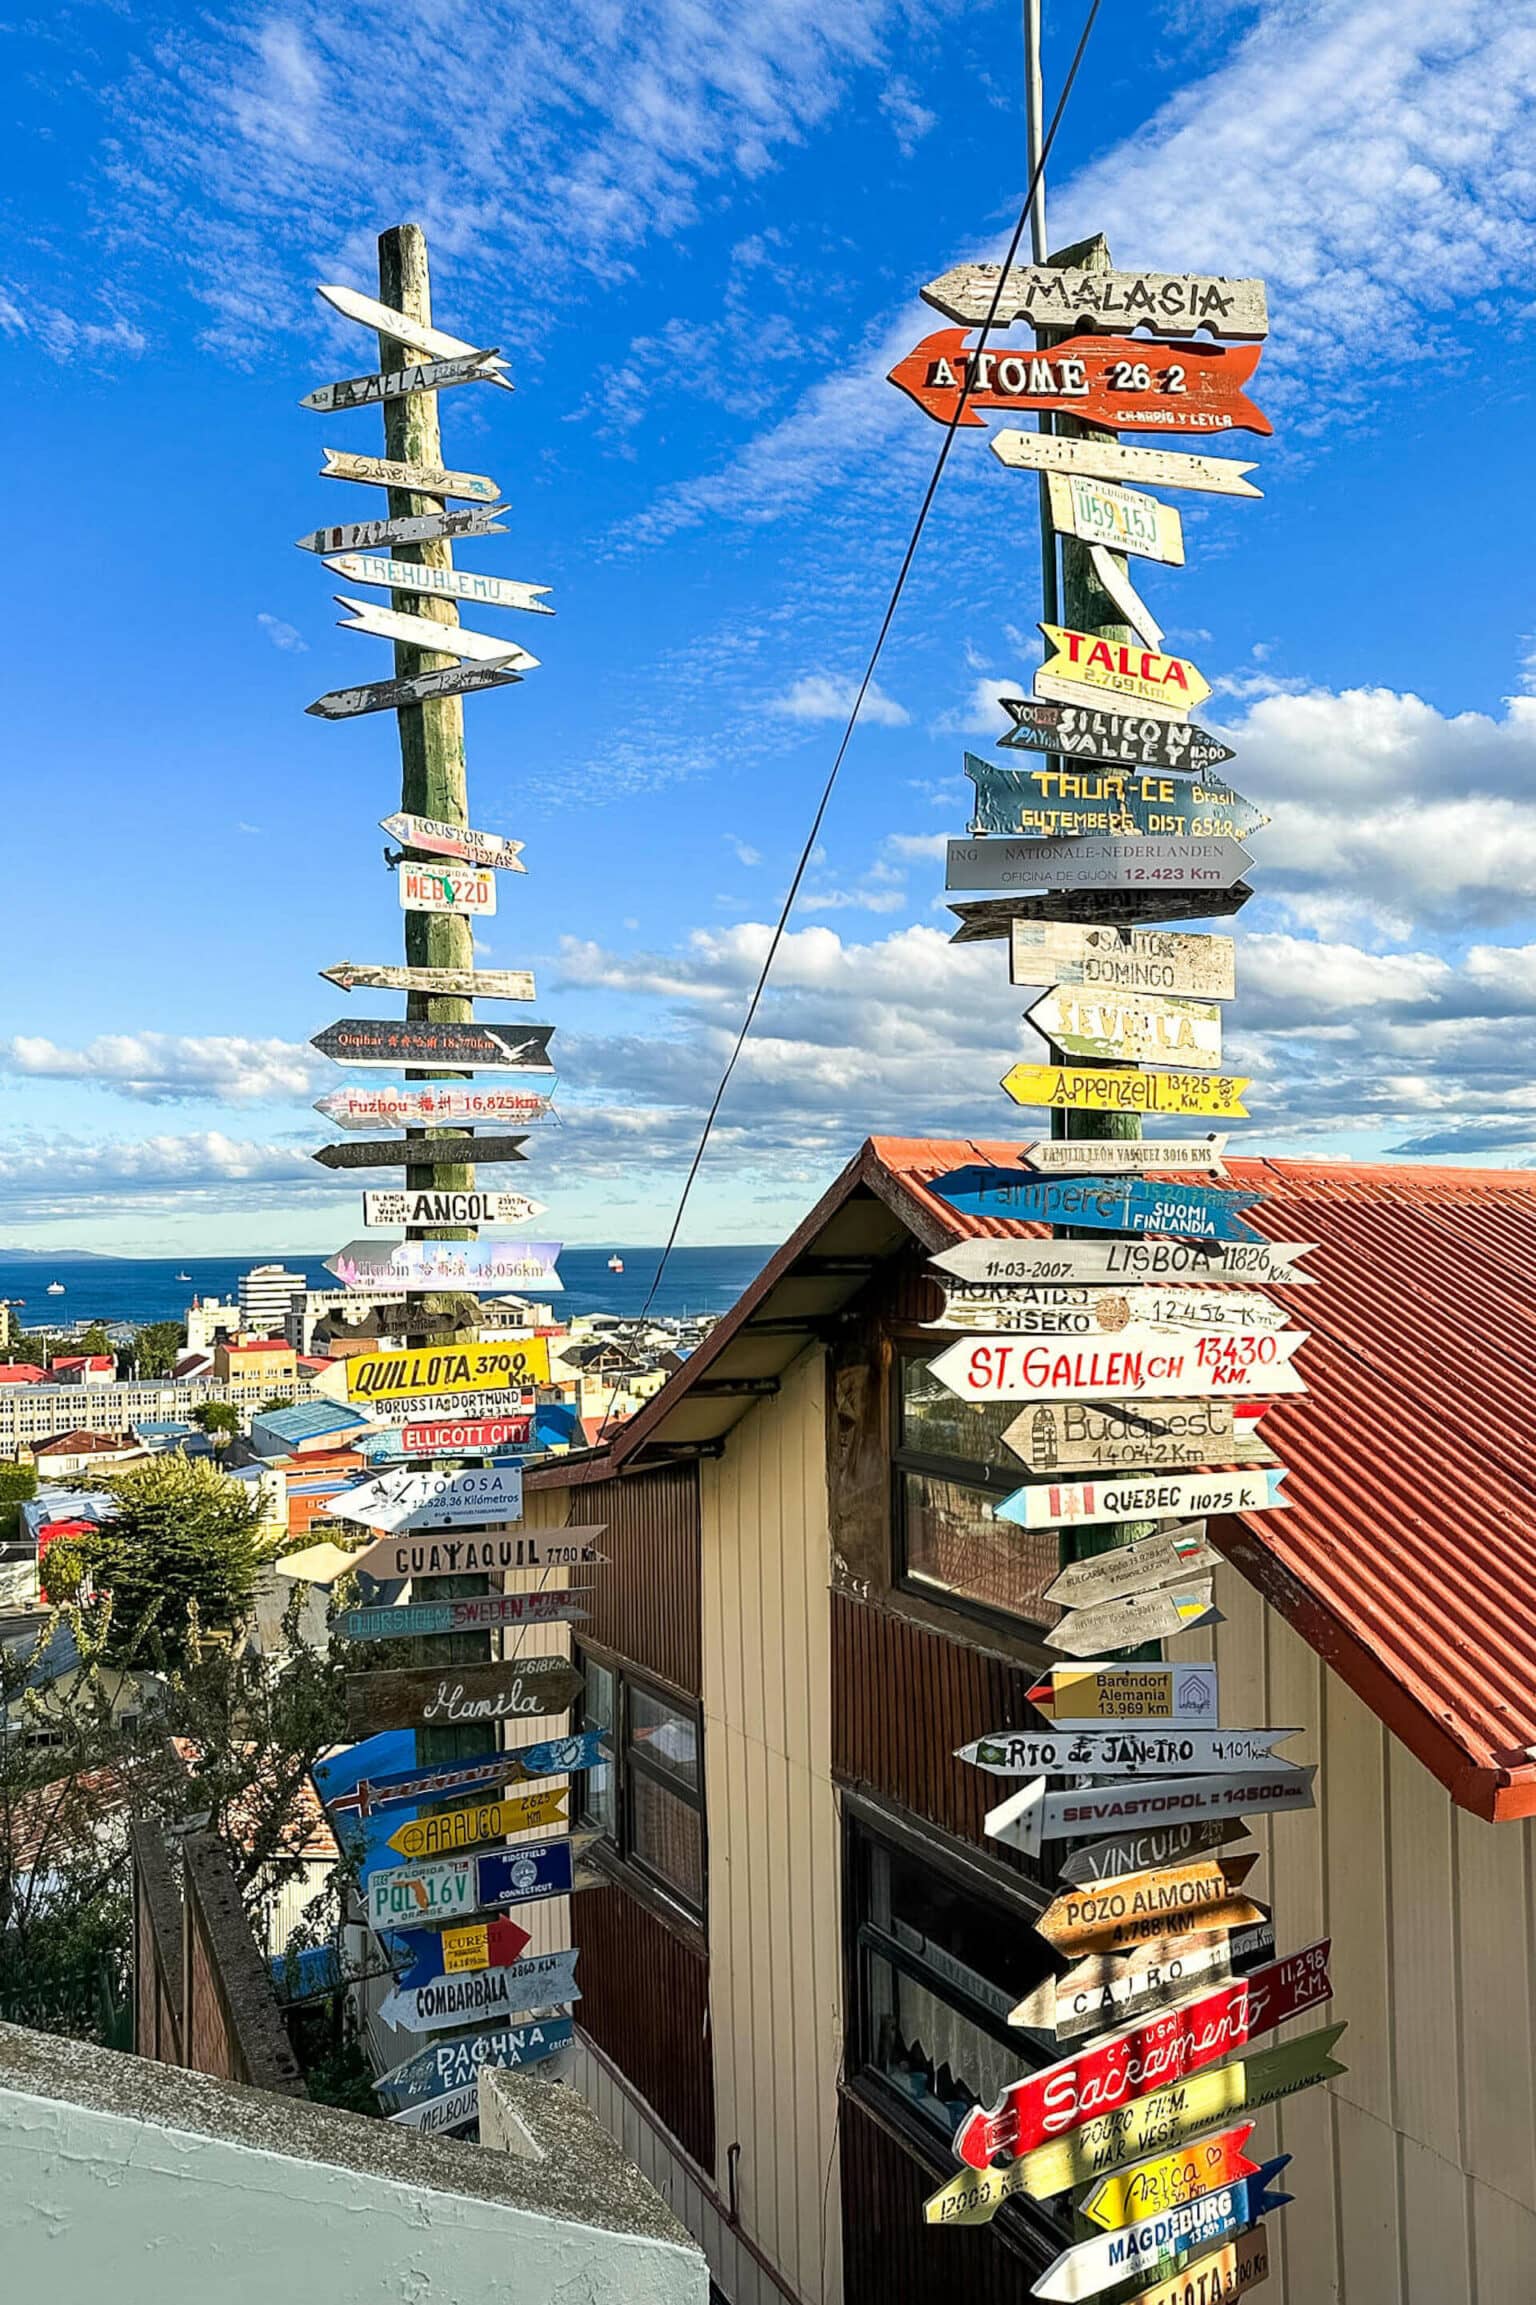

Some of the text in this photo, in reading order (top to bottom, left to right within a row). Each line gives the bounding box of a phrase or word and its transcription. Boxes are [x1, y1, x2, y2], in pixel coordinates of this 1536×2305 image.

[1026, 273, 1234, 317] MALASIA
[933, 357, 958, 386] A
[1178, 413, 1186, 424] Y
[1190, 414, 1232, 426] LEYLA
[1063, 631, 1188, 690] TALCA
[1056, 708, 1193, 746] SILICON
[1059, 733, 1185, 766] VALLEY
[1192, 786, 1235, 806] Brasil
[413, 818, 484, 846] HOUSTON
[1149, 815, 1185, 832] DIST
[463, 846, 513, 867] TEXAS
[950, 845, 1224, 861] ING NATIONALE-NEDERLANDEN
[1001, 872, 1052, 882] OFICINA
[1055, 871, 1073, 881] DE
[1124, 868, 1184, 881] 12.423
[453, 881, 488, 903] 22D
[1087, 959, 1174, 988] DOMINGO
[1167, 1075, 1210, 1094] 13425
[349, 1099, 408, 1113] Fuzhou
[1117, 1148, 1159, 1162] VASQUEZ
[1163, 1149, 1188, 1162] 3016
[971, 1170, 1116, 1218] Tampere
[412, 1194, 495, 1220] ANGOL
[1153, 1202, 1206, 1220] SUOMI
[1134, 1214, 1215, 1235] FINLANDIA
[1106, 1245, 1211, 1274] LISBOA
[1221, 1246, 1271, 1272] 11826
[995, 1309, 1091, 1332] NISEKO
[1147, 1355, 1184, 1379] CH
[375, 1391, 519, 1415] BORUSSIA DORTMUND
[406, 1425, 527, 1448] ELLICOTT CITY
[1064, 1402, 1227, 1448] Budapest
[421, 1477, 503, 1494] TOLOSA
[464, 1494, 519, 1505] Kilómetros
[1103, 1487, 1181, 1511] QUEBEC
[1190, 1493, 1233, 1511] 11075
[396, 1540, 540, 1574] GUAYAQUIL
[454, 1598, 523, 1624] SWEDEN
[1097, 1674, 1168, 1687] Barendorf
[423, 1678, 545, 1720] Manila
[1099, 1689, 1165, 1701] Alemania
[1098, 1703, 1144, 1714] 13.969
[1148, 1702, 1169, 1714] km
[1062, 1784, 1284, 1822] SEVASTOPOL 14500
[426, 1806, 501, 1851] ARAUCO
[502, 1849, 547, 1863] RIDGEFIELD
[1088, 1822, 1192, 1881] VINCULO
[397, 1865, 445, 1879] FLORIDA
[428, 1874, 467, 1903] 16V
[499, 1883, 553, 1899] CONNECTICUT
[1067, 1875, 1235, 1926] POZO ALMONTE
[1113, 1910, 1195, 1943] 4.788 KM
[1280, 1949, 1326, 1986] 11.298
[1144, 2021, 1177, 2044] USA
[444, 2051, 522, 2088] ΕΛΛΔΑ
[1042, 1985, 1271, 2133] Sacramento
[419, 2088, 478, 2132] MELBOUR
[1092, 2140, 1126, 2171] HAR
[1108, 2191, 1232, 2266] MAGDEBURG
